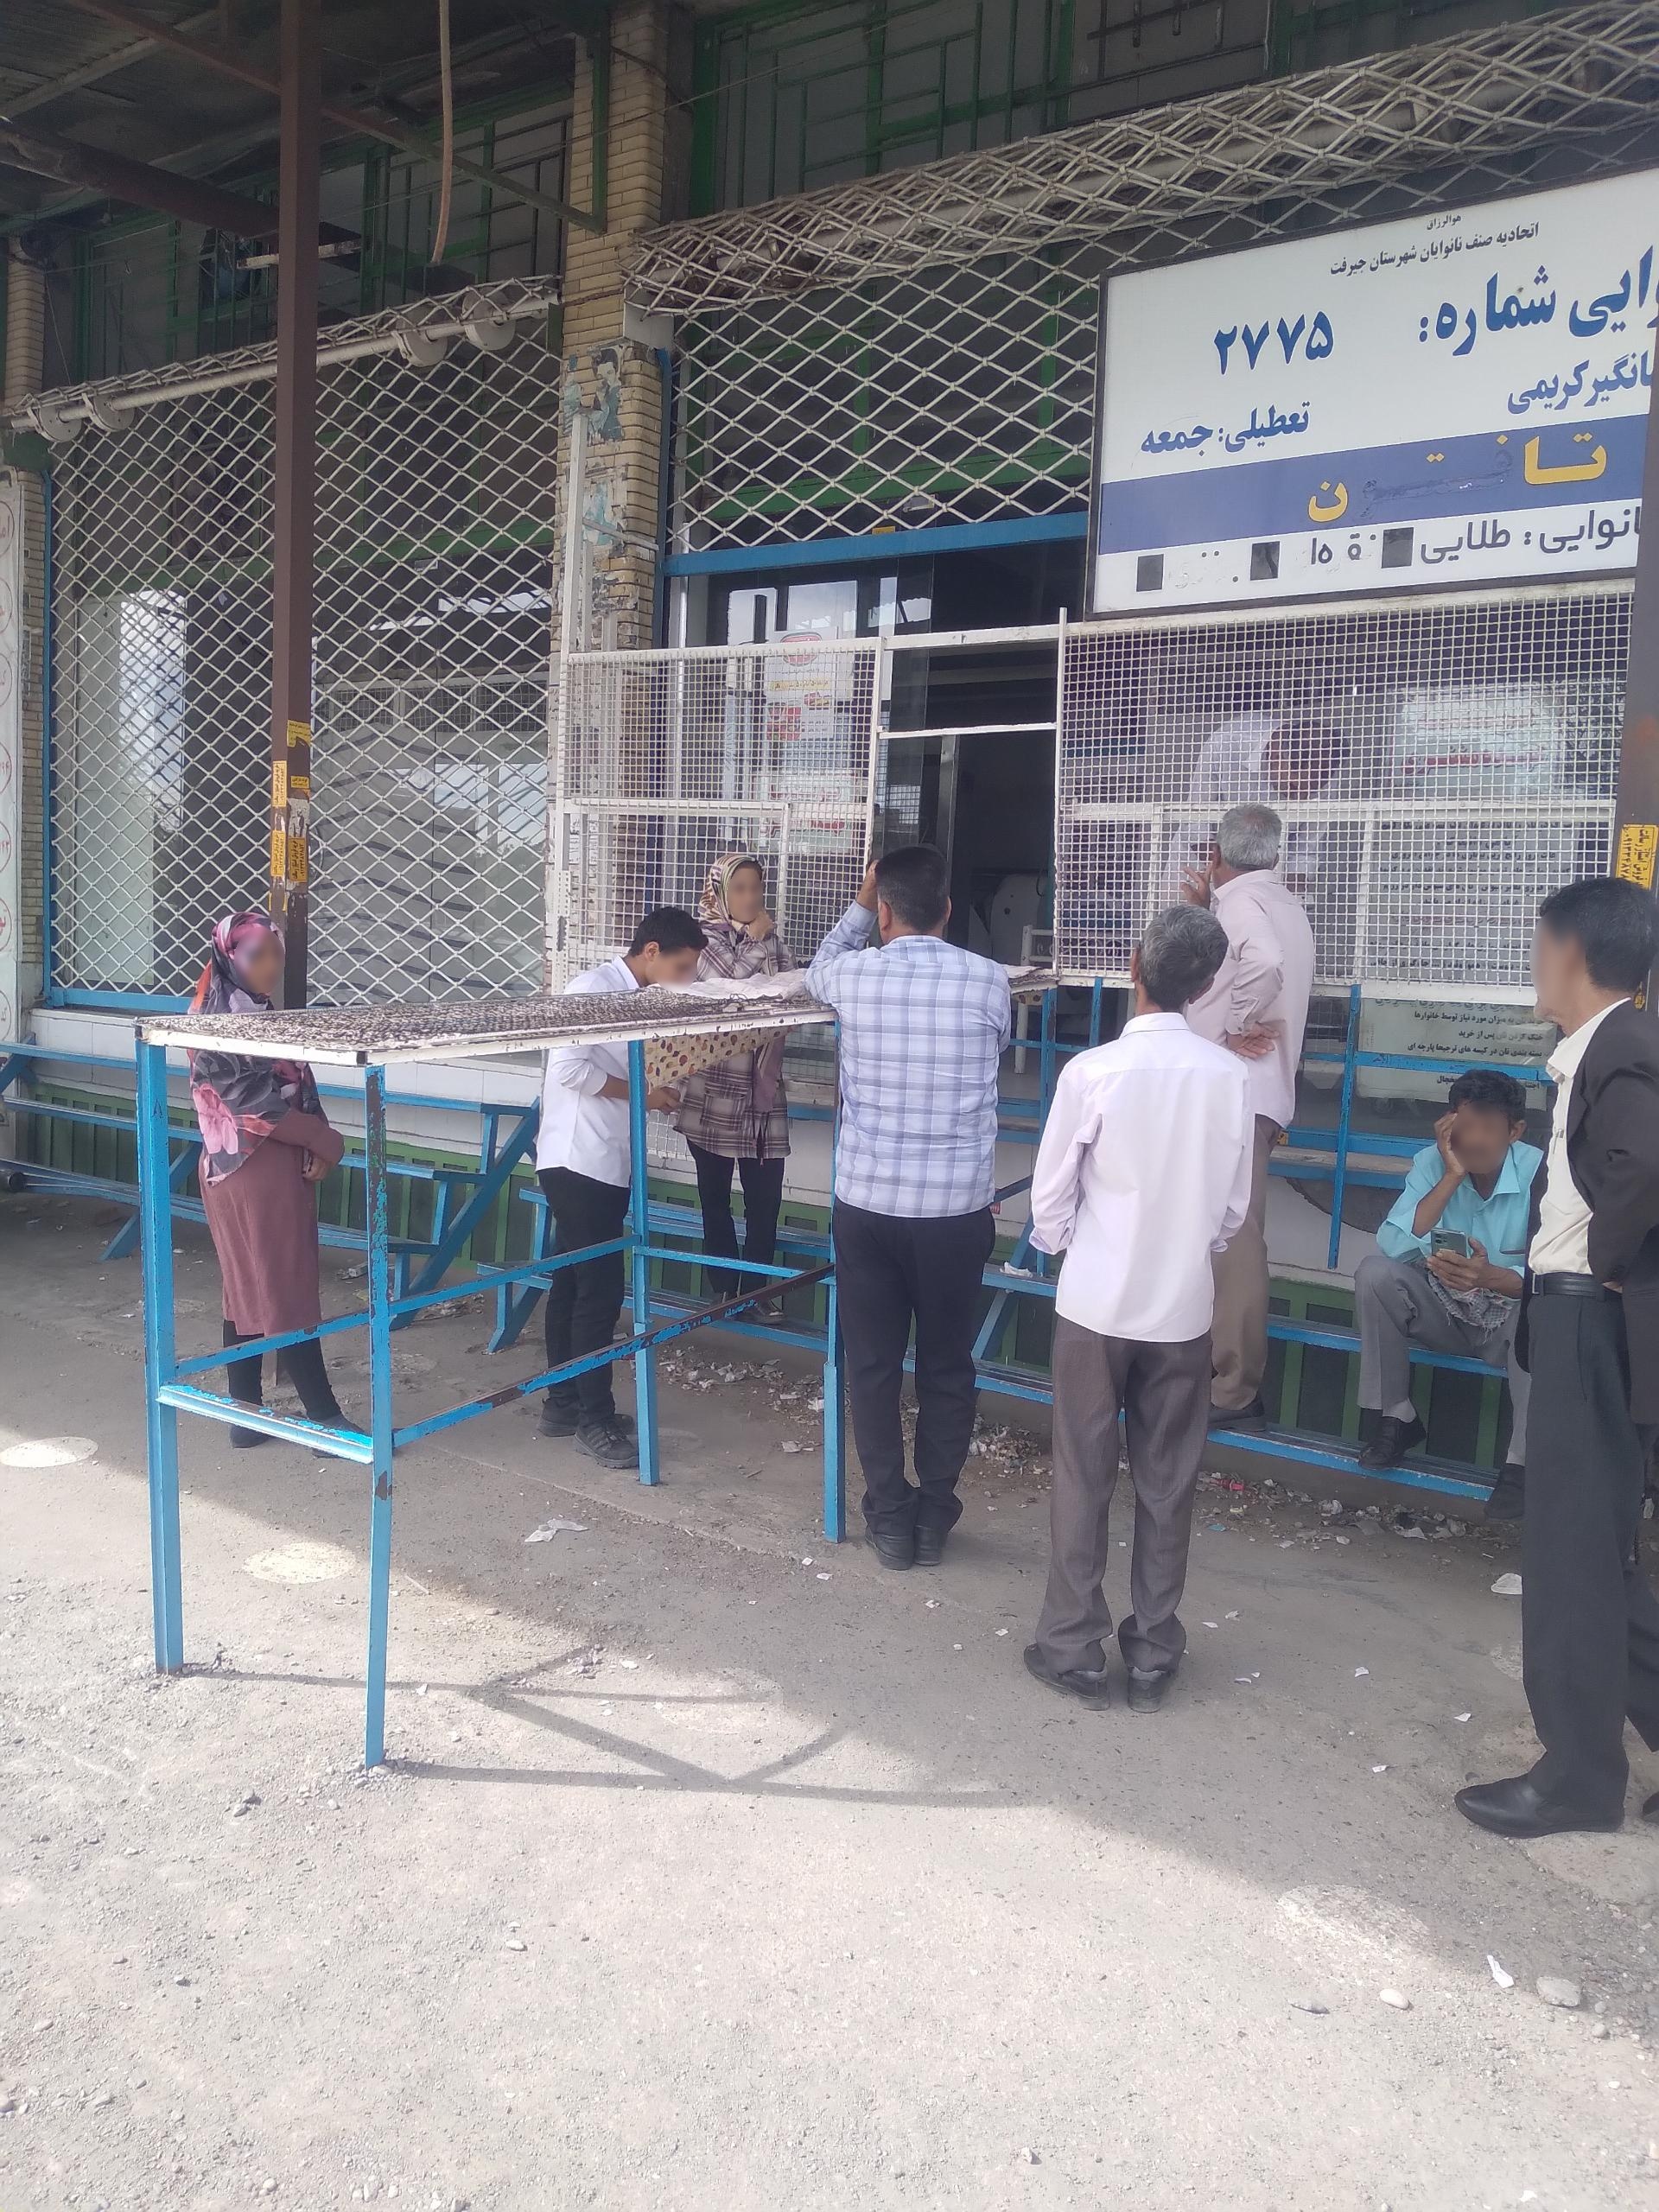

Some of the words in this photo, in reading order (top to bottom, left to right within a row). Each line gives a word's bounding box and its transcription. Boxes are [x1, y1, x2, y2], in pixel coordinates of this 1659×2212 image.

[1426, 213, 1462, 231] هوالرزاق
[1496, 221, 1540, 249] اتحادیه
[1420, 236, 1462, 263] نانوایان
[1465, 232, 1493, 251] صنف
[1330, 257, 1366, 277] جیرفت
[1369, 245, 1417, 274] شهرستان
[1213, 310, 1336, 376] ۲۷۷۵
[1141, 423, 1215, 458] جمعه
[1420, 518, 1511, 564] طلایی
[1522, 506, 1642, 555] انوایی:
[1414, 1010, 1440, 1021] خانوارها
[1441, 1012, 1459, 1023] توسط
[1459, 1029, 1475, 1039] خرید
